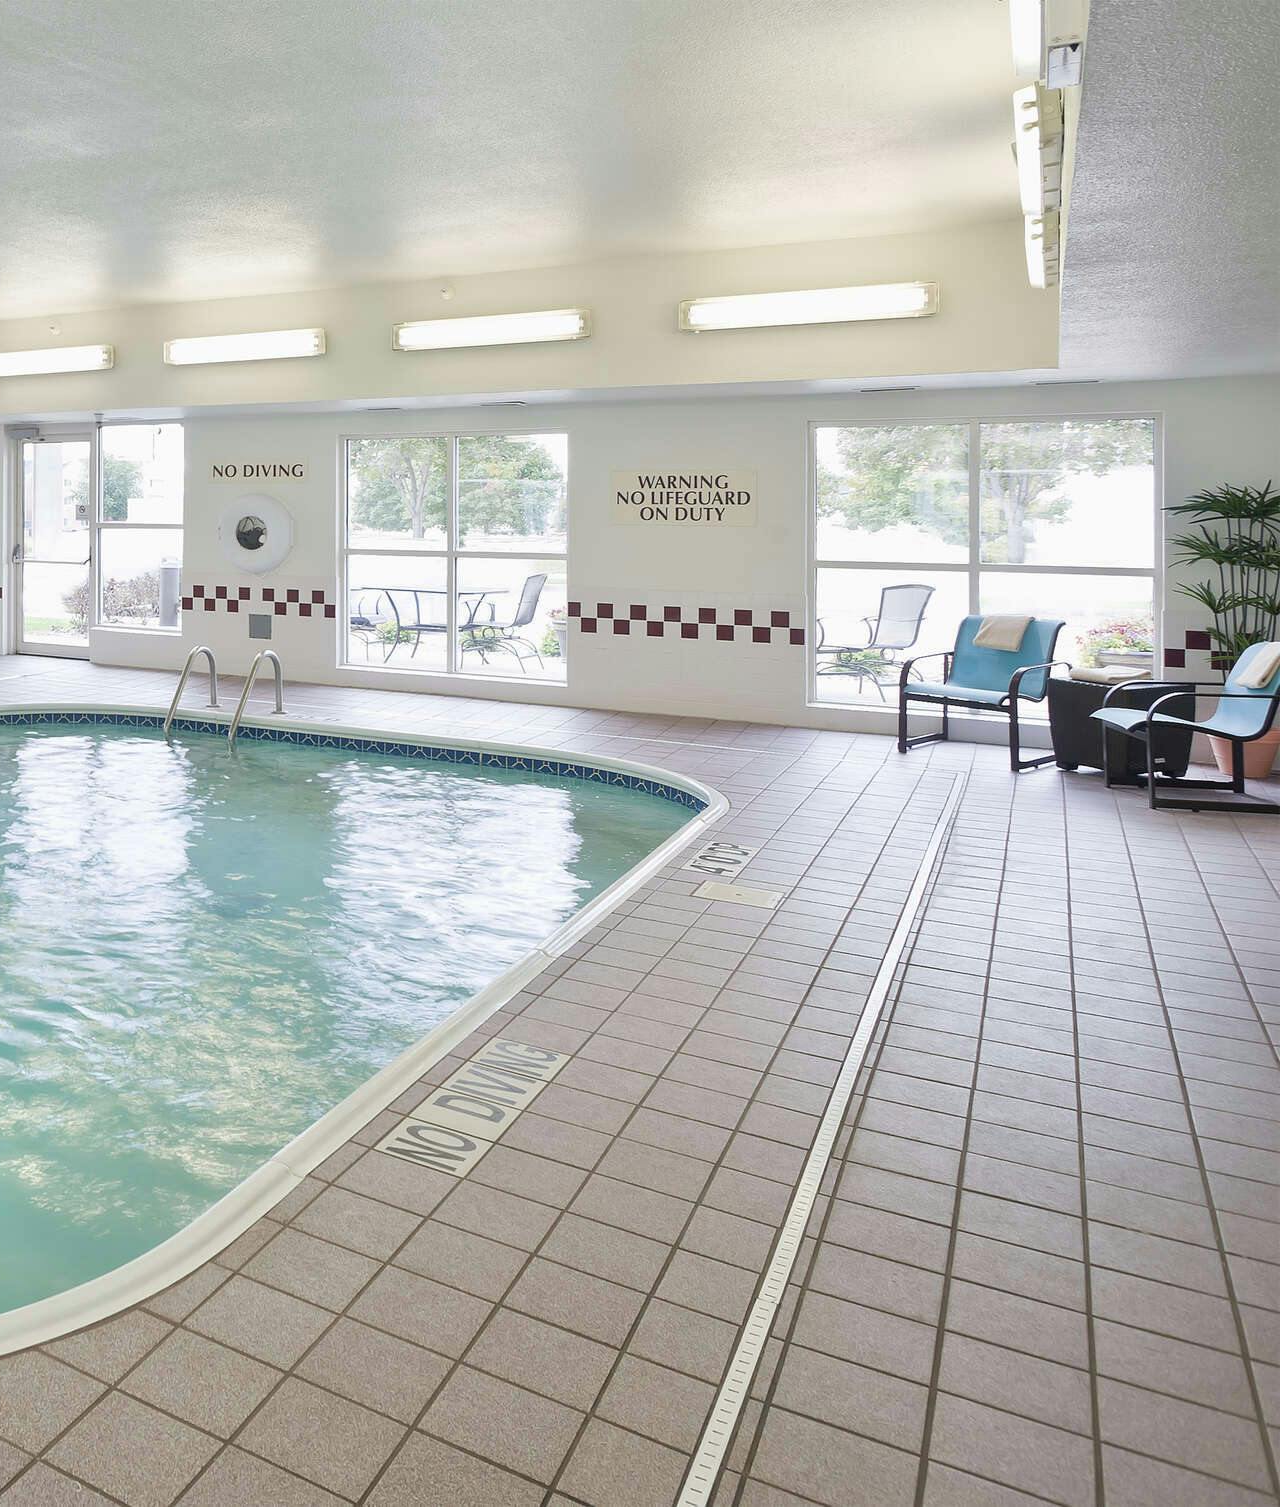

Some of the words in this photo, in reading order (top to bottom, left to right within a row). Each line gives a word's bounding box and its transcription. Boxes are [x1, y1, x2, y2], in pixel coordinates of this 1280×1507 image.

[212, 464, 237, 478] NO
[243, 464, 303, 478] DIVING
[638, 475, 728, 489] WARNING
[616, 491, 645, 505] NO
[651, 491, 751, 505] LIFEGUARD
[640, 507, 668, 521] ON
[675, 507, 725, 521] DUTY
[385, 1125, 477, 1171] NO
[432, 1042, 559, 1123] DIVING
